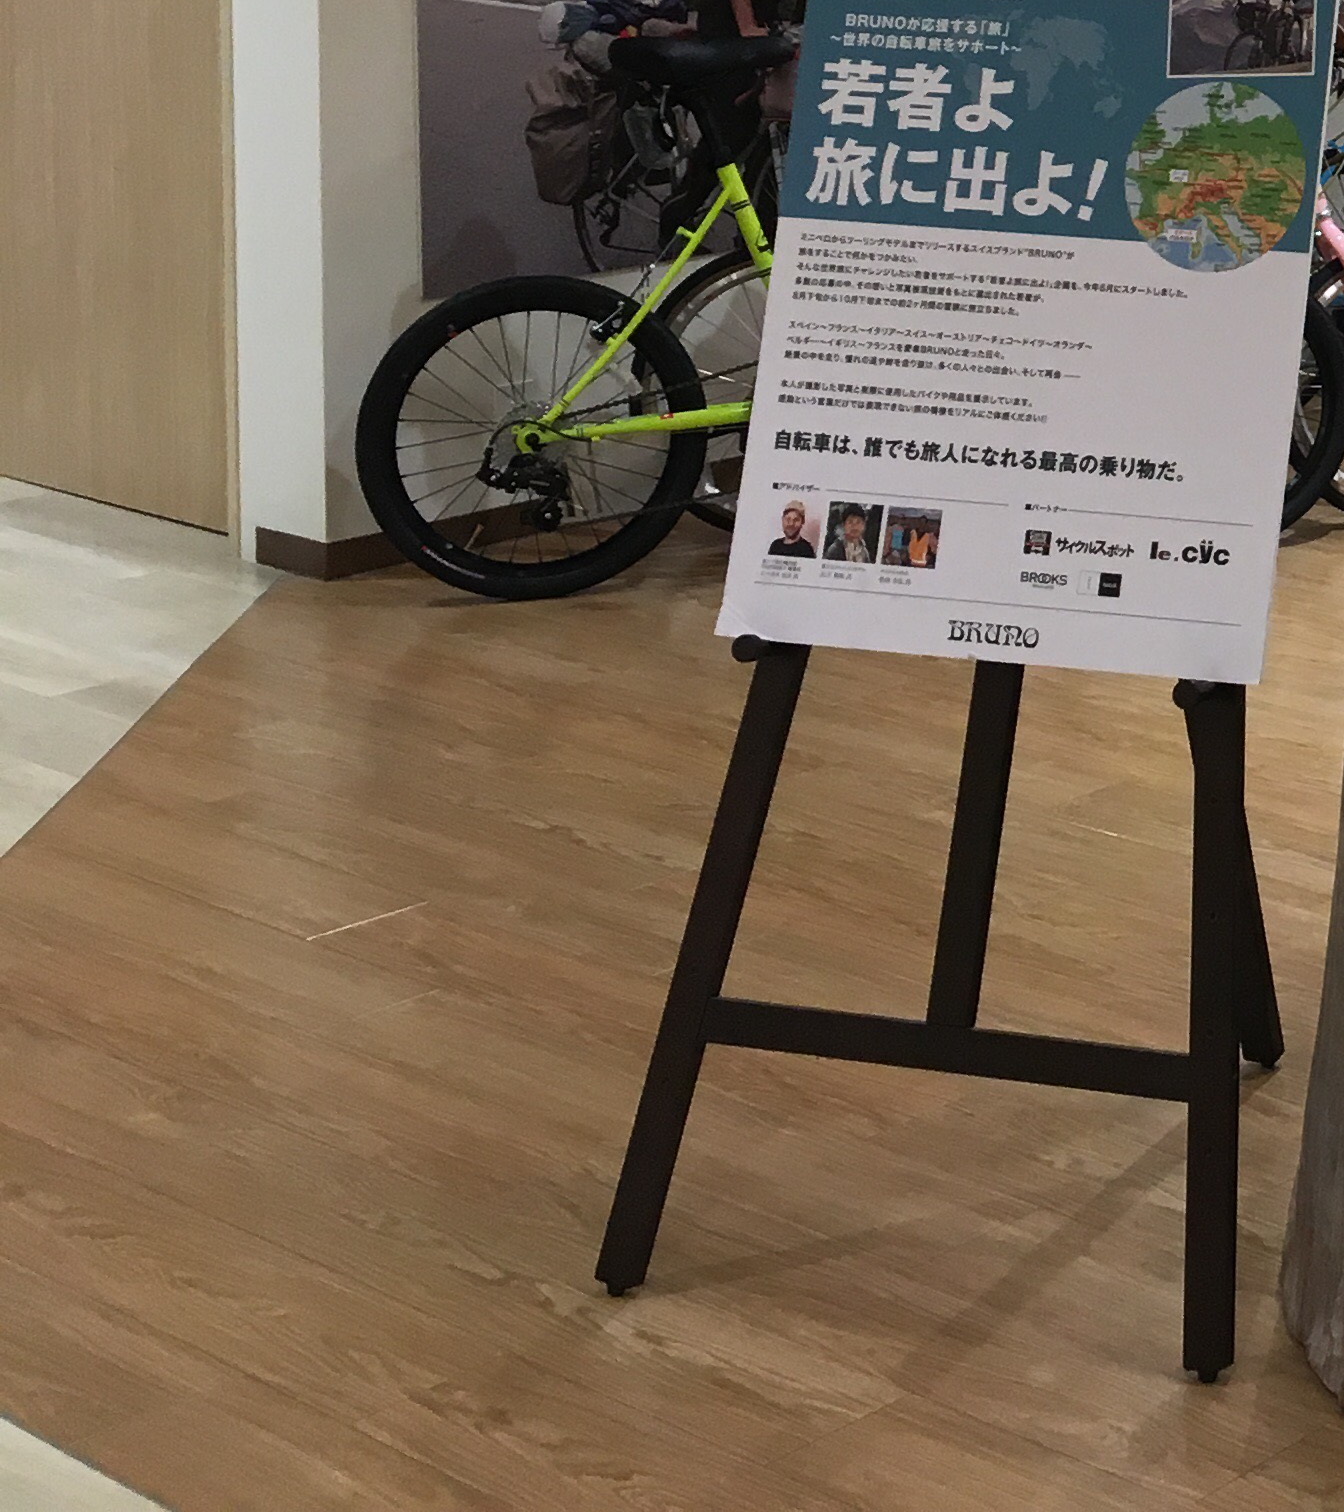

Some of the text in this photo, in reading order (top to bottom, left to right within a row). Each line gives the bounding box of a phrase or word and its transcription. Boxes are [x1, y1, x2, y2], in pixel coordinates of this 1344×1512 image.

[844, 13, 1011, 37] BRUNOが応援する「旅」
[818, 58, 1016, 132] 若者よ
[773, 429, 1185, 484] 自転車は、誰でも旅人になれる最高の乗り物だ。
[1055, 537, 1135, 558] サイクルスポット
[1020, 571, 1068, 586] BROOKS
[946, 619, 1040, 649] BRUNO
